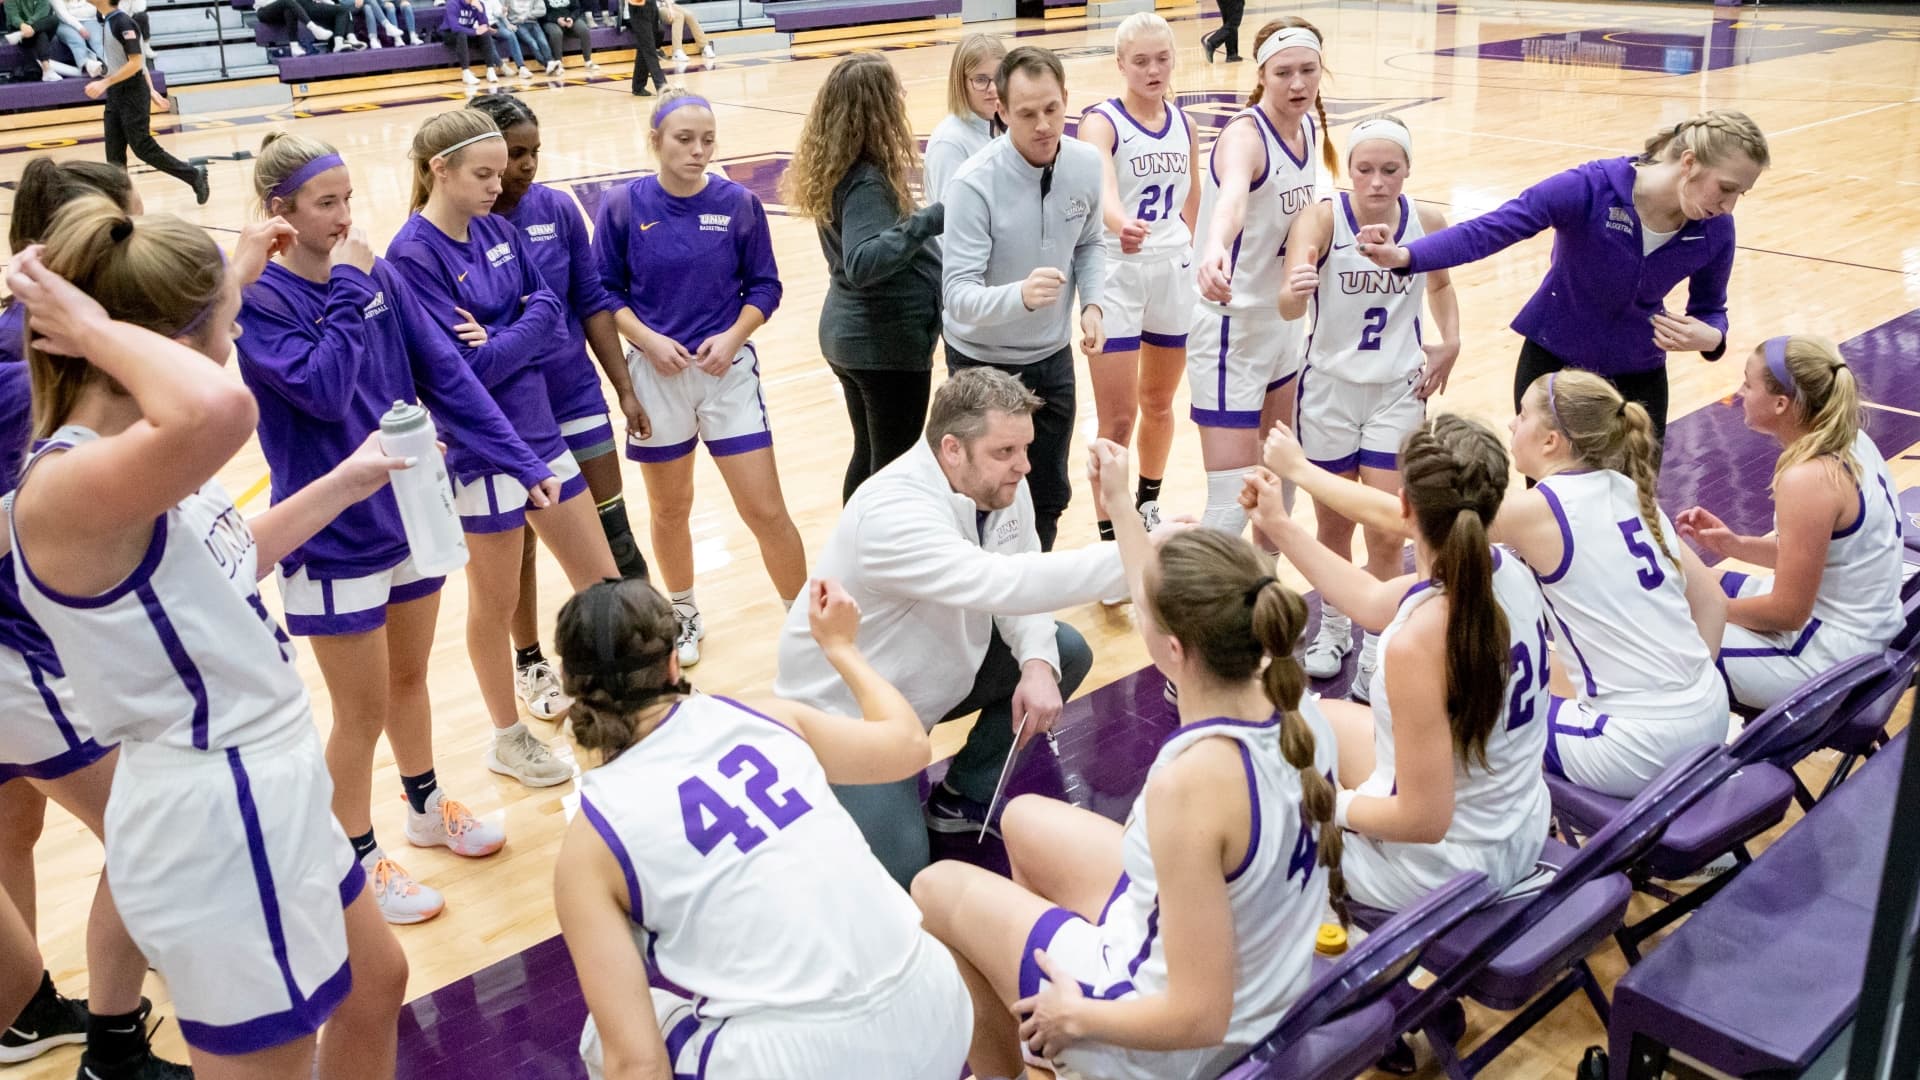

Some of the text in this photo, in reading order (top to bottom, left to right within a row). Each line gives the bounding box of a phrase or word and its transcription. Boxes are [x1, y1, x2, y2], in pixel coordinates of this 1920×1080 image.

[1130, 152, 1188, 177] UNW
[1137, 184, 1175, 222] 21
[525, 222, 555, 236] UNW
[698, 213, 731, 226] UNW
[486, 241, 511, 262] UNW
[1338, 269, 1413, 295] UNW
[1358, 306, 1388, 350] 2
[1617, 516, 1666, 591] 5
[678, 744, 814, 857] 42
